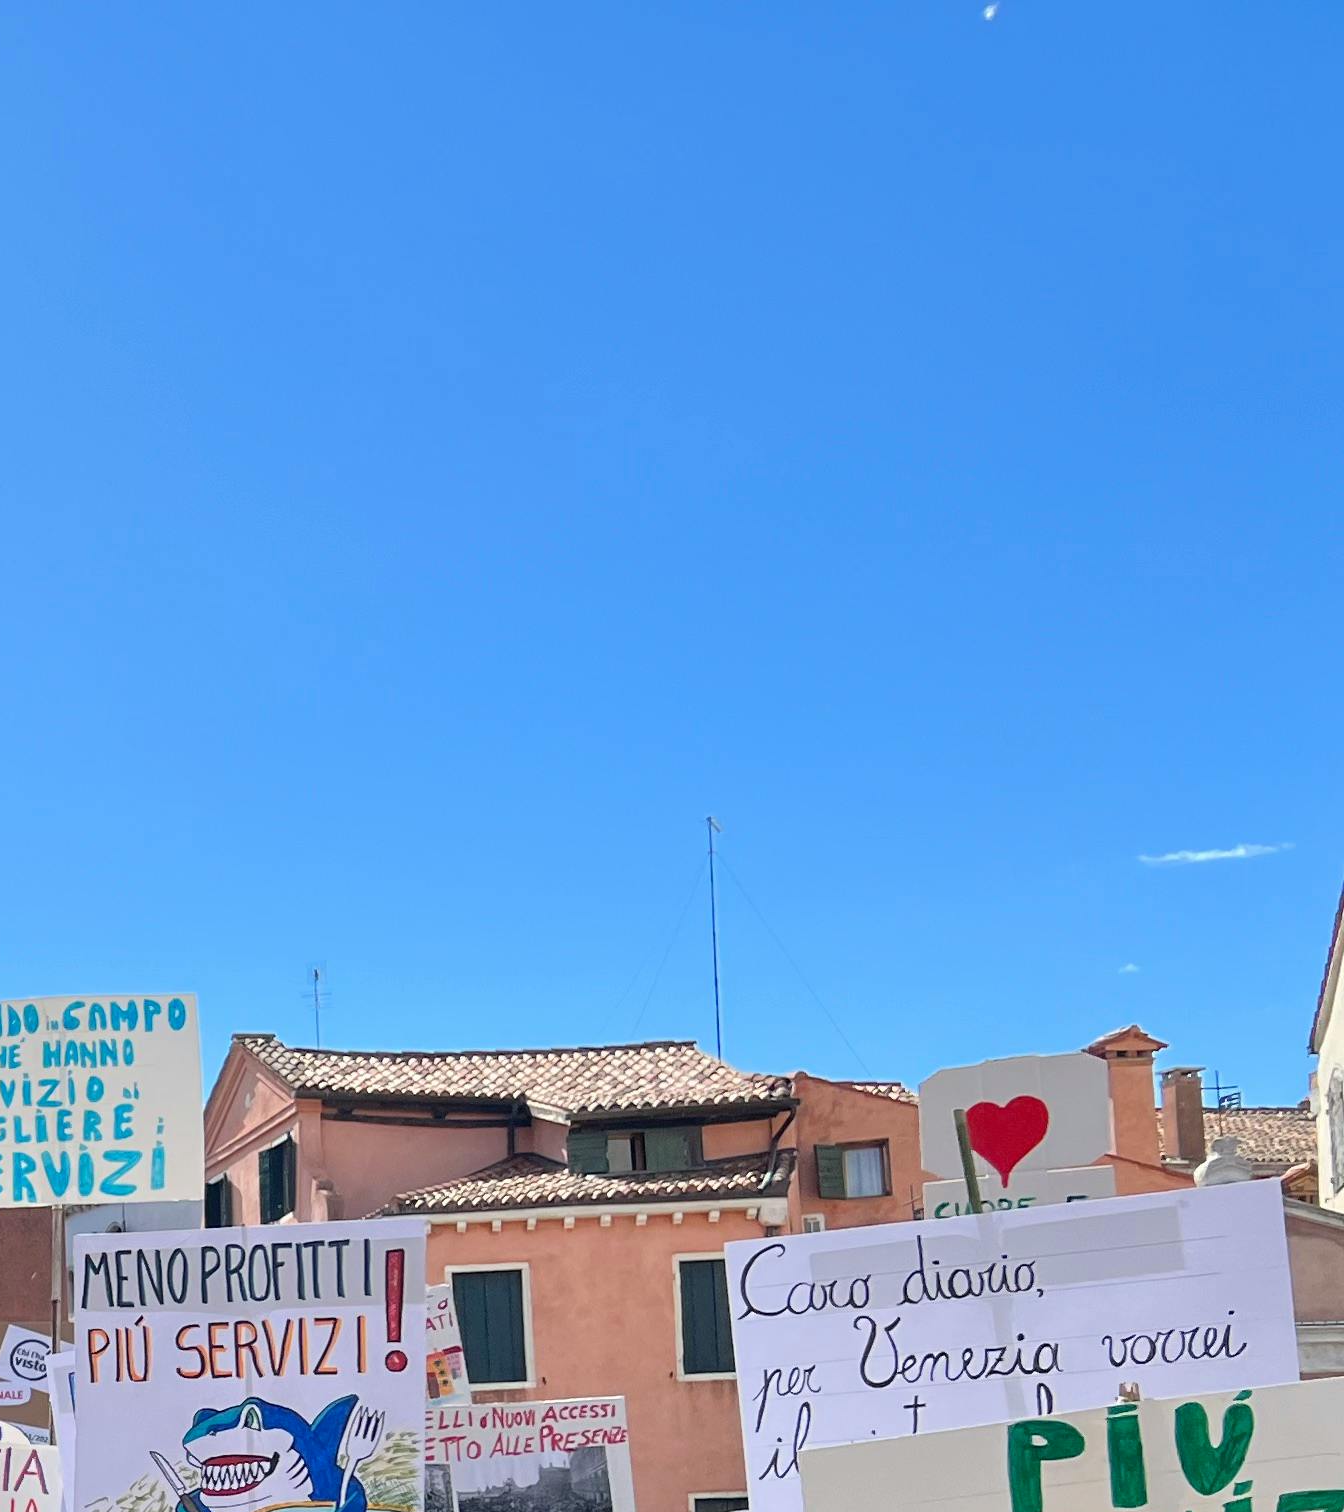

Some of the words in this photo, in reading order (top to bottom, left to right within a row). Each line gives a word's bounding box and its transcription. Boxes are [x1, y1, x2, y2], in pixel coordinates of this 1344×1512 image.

[62, 998, 186, 1032] CAMPO
[43, 1038, 134, 1069] HANNO
[81, 1247, 188, 1309] MENO
[200, 1238, 372, 1305] PROFITTI
[739, 1244, 872, 1318] Caro
[176, 1317, 368, 1380] SERVIZI
[854, 1316, 1063, 1388] Venezia
[492, 1407, 536, 1429] NUOVI
[541, 1403, 616, 1423] ACCESSI
[489, 1432, 536, 1458] ALLE
